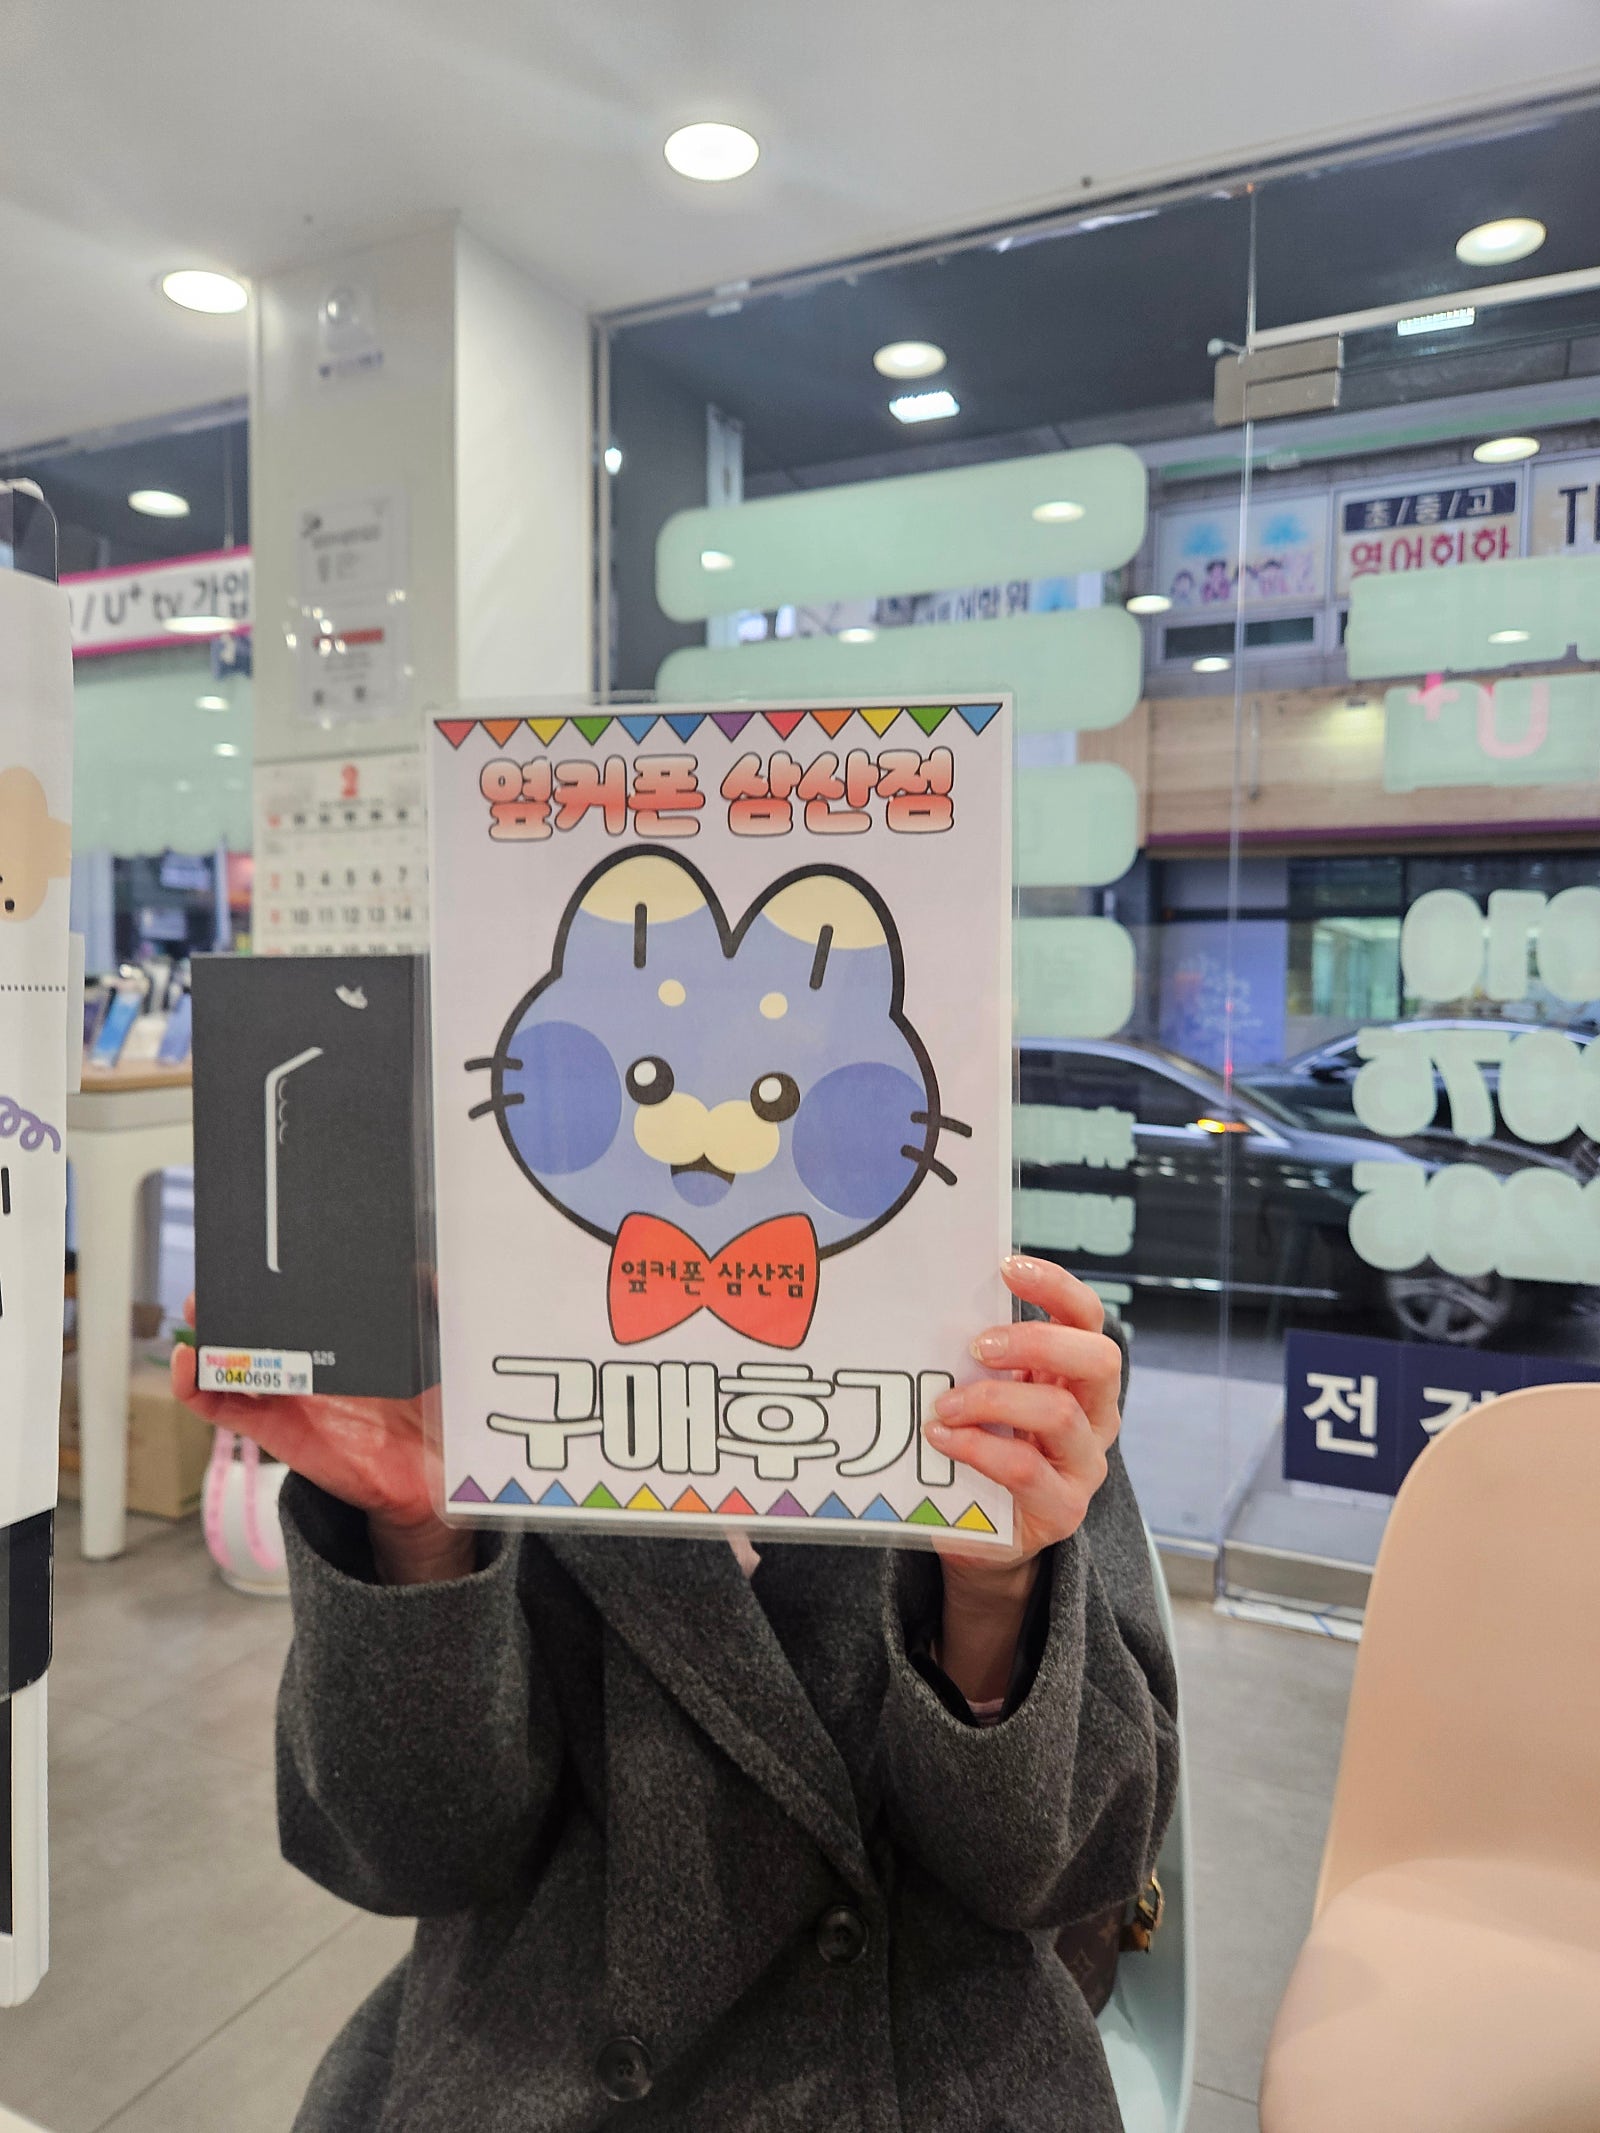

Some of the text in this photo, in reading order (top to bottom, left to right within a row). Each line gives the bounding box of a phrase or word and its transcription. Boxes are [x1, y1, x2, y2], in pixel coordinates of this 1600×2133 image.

[479, 746, 954, 842] 옆커폰 삼산점
[620, 1259, 806, 1299] 옆커폰 삼산점
[215, 1369, 281, 1388] 0040695
[486, 1355, 955, 1485] 구매후기
[1302, 1372, 1378, 1458] 전
